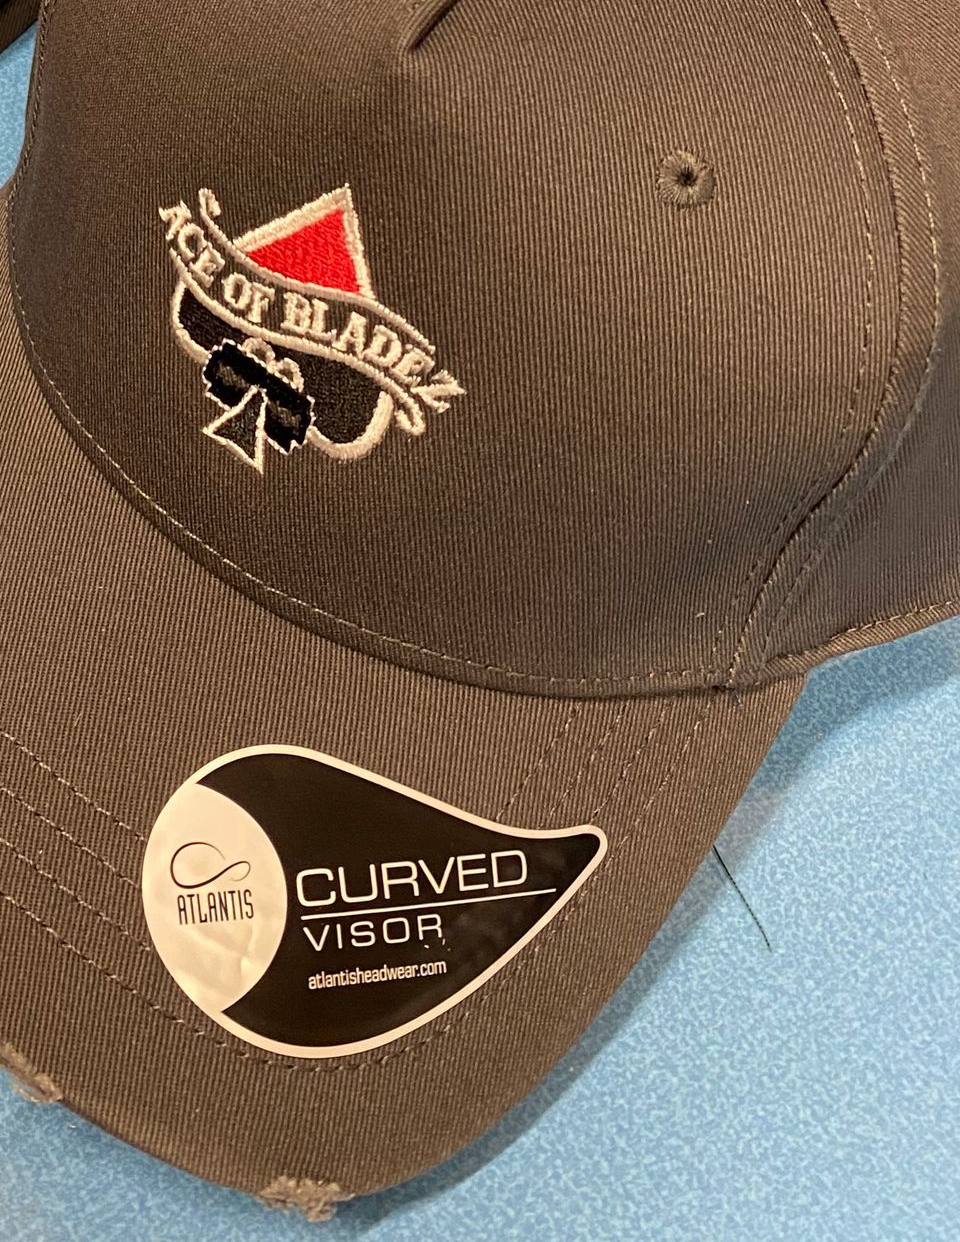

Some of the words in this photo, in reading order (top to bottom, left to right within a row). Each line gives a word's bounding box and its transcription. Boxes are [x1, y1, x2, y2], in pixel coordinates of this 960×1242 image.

[159, 199, 226, 288] ACE
[222, 272, 276, 324] OF
[280, 292, 467, 414] BLADEZ
[295, 849, 529, 908] CURVED
[178, 888, 255, 926] ATLANTIS
[302, 913, 443, 952] VISOR
[308, 960, 448, 991] atlantisheadwear.com
